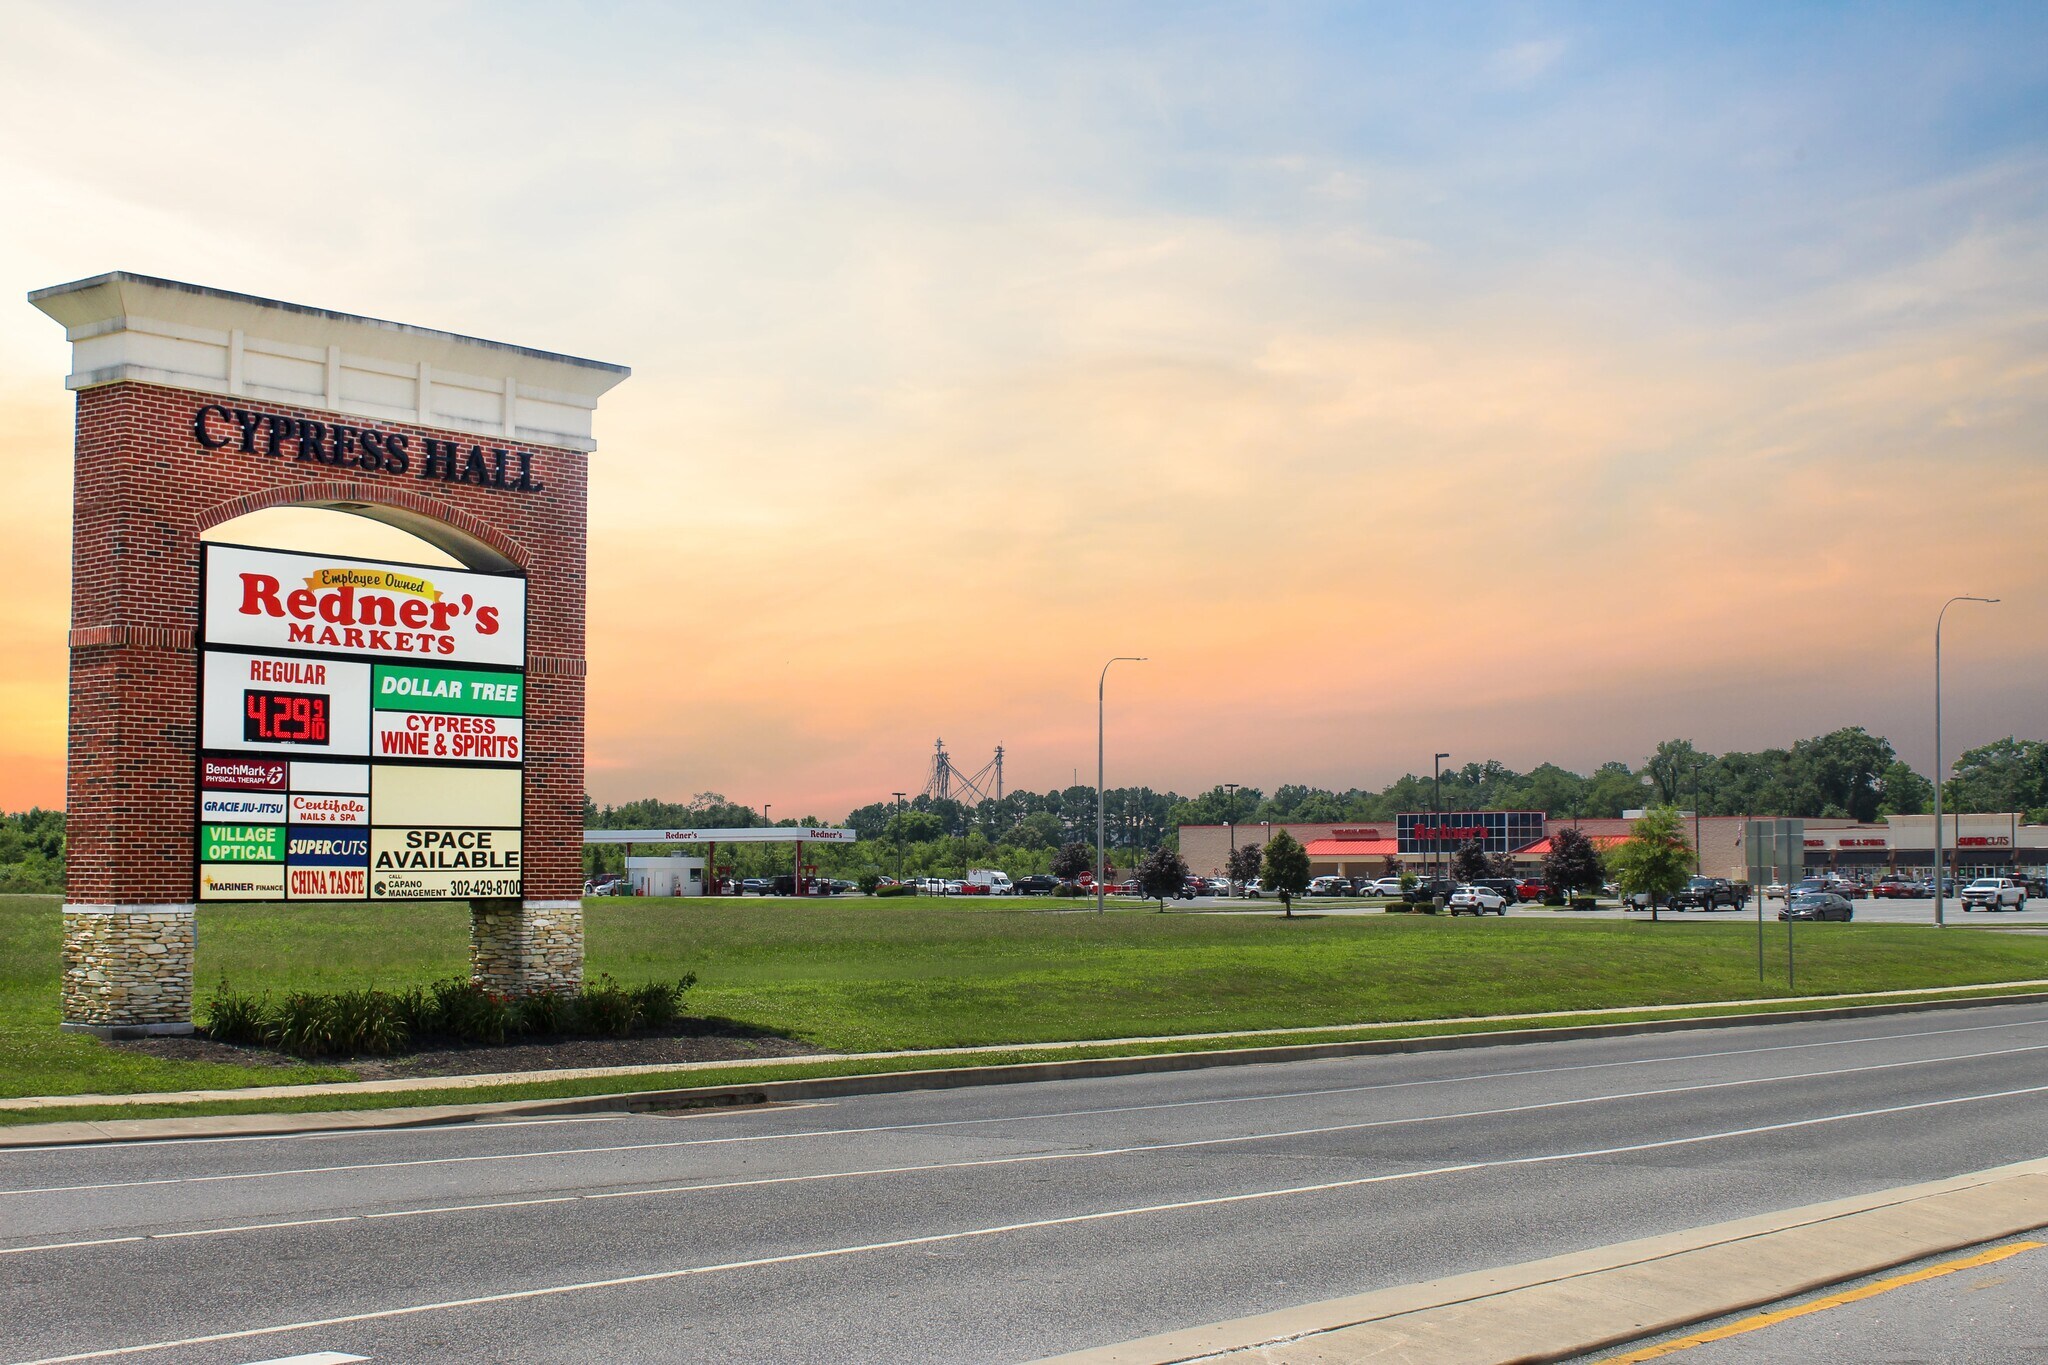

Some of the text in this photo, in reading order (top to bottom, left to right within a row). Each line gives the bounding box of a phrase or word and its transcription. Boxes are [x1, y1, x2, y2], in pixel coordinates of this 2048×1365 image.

[195, 405, 544, 492] CYPRESS HALL
[322, 570, 425, 593] Employee Owned
[238, 573, 500, 635] Redner's
[287, 623, 456, 655] MARKETS
[250, 660, 326, 685] REGULAR
[381, 676, 518, 702] DOLLAR TREE
[247, 695, 311, 739] 4.29
[406, 715, 496, 734] CYPRESS
[381, 731, 519, 758] WINE & SPIRITS
[206, 763, 266, 776] BenchMark
[205, 775, 236, 783] PHYSICAL
[204, 801, 283, 813] GRACIE JIU-JITSU
[293, 797, 365, 813] Centifola
[300, 813, 356, 821] NAILS & SPA
[210, 827, 276, 842] VILLAGE
[406, 830, 492, 849] SPACE
[665, 831, 697, 840] Redner's
[810, 829, 843, 839] Redner's
[1957, 836, 2009, 846] SUPERCUTS
[209, 845, 276, 860] OPTICAL
[288, 839, 367, 856] SUPERCUTS
[375, 851, 519, 869] AVAILABLE
[209, 882, 254, 891] MARINER
[291, 870, 365, 895] CHINA TASTE
[388, 880, 422, 888] CAPANO
[1079, 875, 1092, 883] STOP
[388, 889, 447, 897] MANAGEMENT
[450, 879, 521, 896] 302-429-8700
